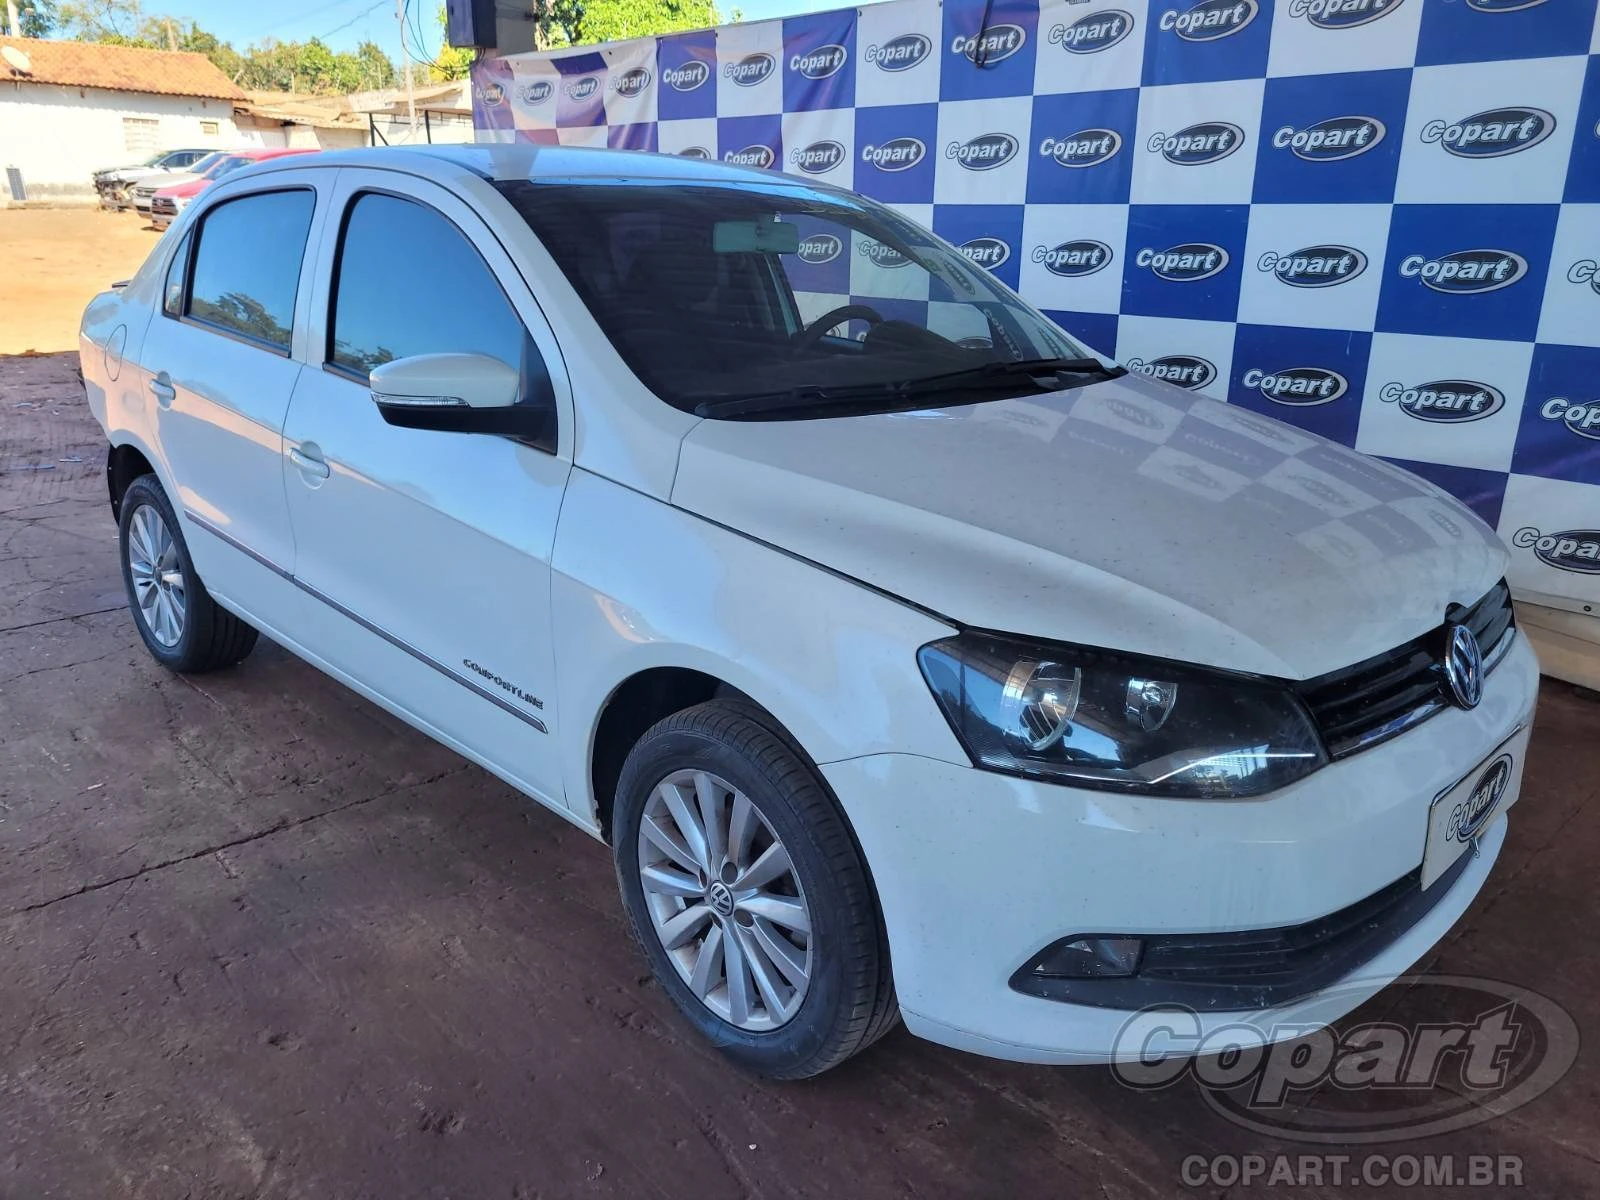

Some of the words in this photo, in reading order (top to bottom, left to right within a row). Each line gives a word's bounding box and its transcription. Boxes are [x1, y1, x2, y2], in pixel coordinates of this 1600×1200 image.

[1048, 16, 1121, 45] Copart
[1159, 3, 1245, 33] Copart
[790, 49, 841, 73] Copart
[865, 38, 922, 65] Copart
[663, 67, 703, 86] Copart
[723, 59, 768, 79] Copart
[1147, 128, 1231, 156] Copart
[1272, 120, 1371, 151] Copart
[1420, 113, 1538, 146] Copart
[790, 147, 837, 167] Copart
[862, 142, 916, 165] Copart
[945, 139, 1009, 163] Copart
[1040, 133, 1109, 159] Copart
[799, 241, 835, 257] opart
[859, 240, 900, 259] Copa
[1031, 244, 1101, 267] Copart
[1135, 247, 1218, 272] Copart
[1257, 250, 1352, 278] Copart
[1400, 255, 1511, 284] Copart
[1243, 368, 1335, 396] Copart
[1380, 382, 1487, 412] Copart
[1446, 766, 1505, 842] Copart
